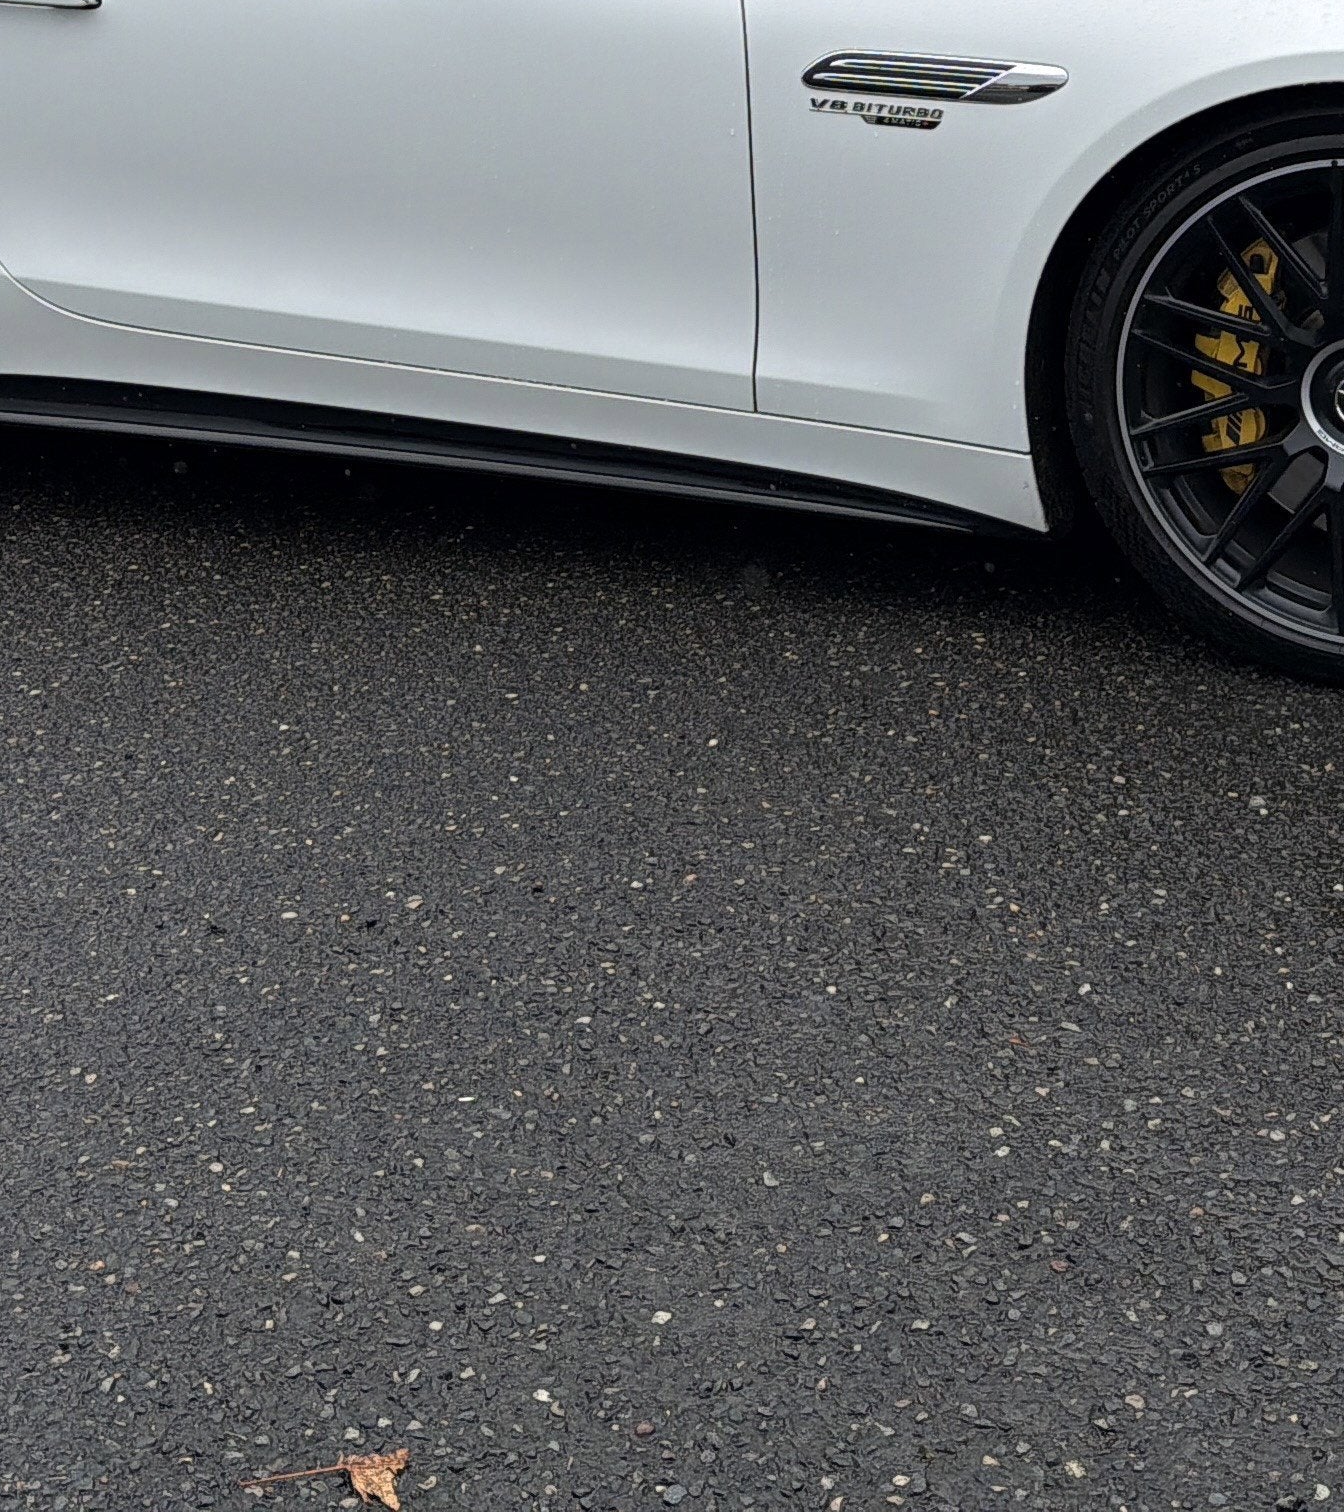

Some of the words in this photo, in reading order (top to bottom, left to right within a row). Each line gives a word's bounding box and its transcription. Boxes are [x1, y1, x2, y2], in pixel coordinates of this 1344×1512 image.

[810, 98, 848, 111] V8
[852, 101, 944, 120] BITURBO
[1113, 219, 1141, 261] PILOT
[1142, 175, 1184, 216] SPORT
